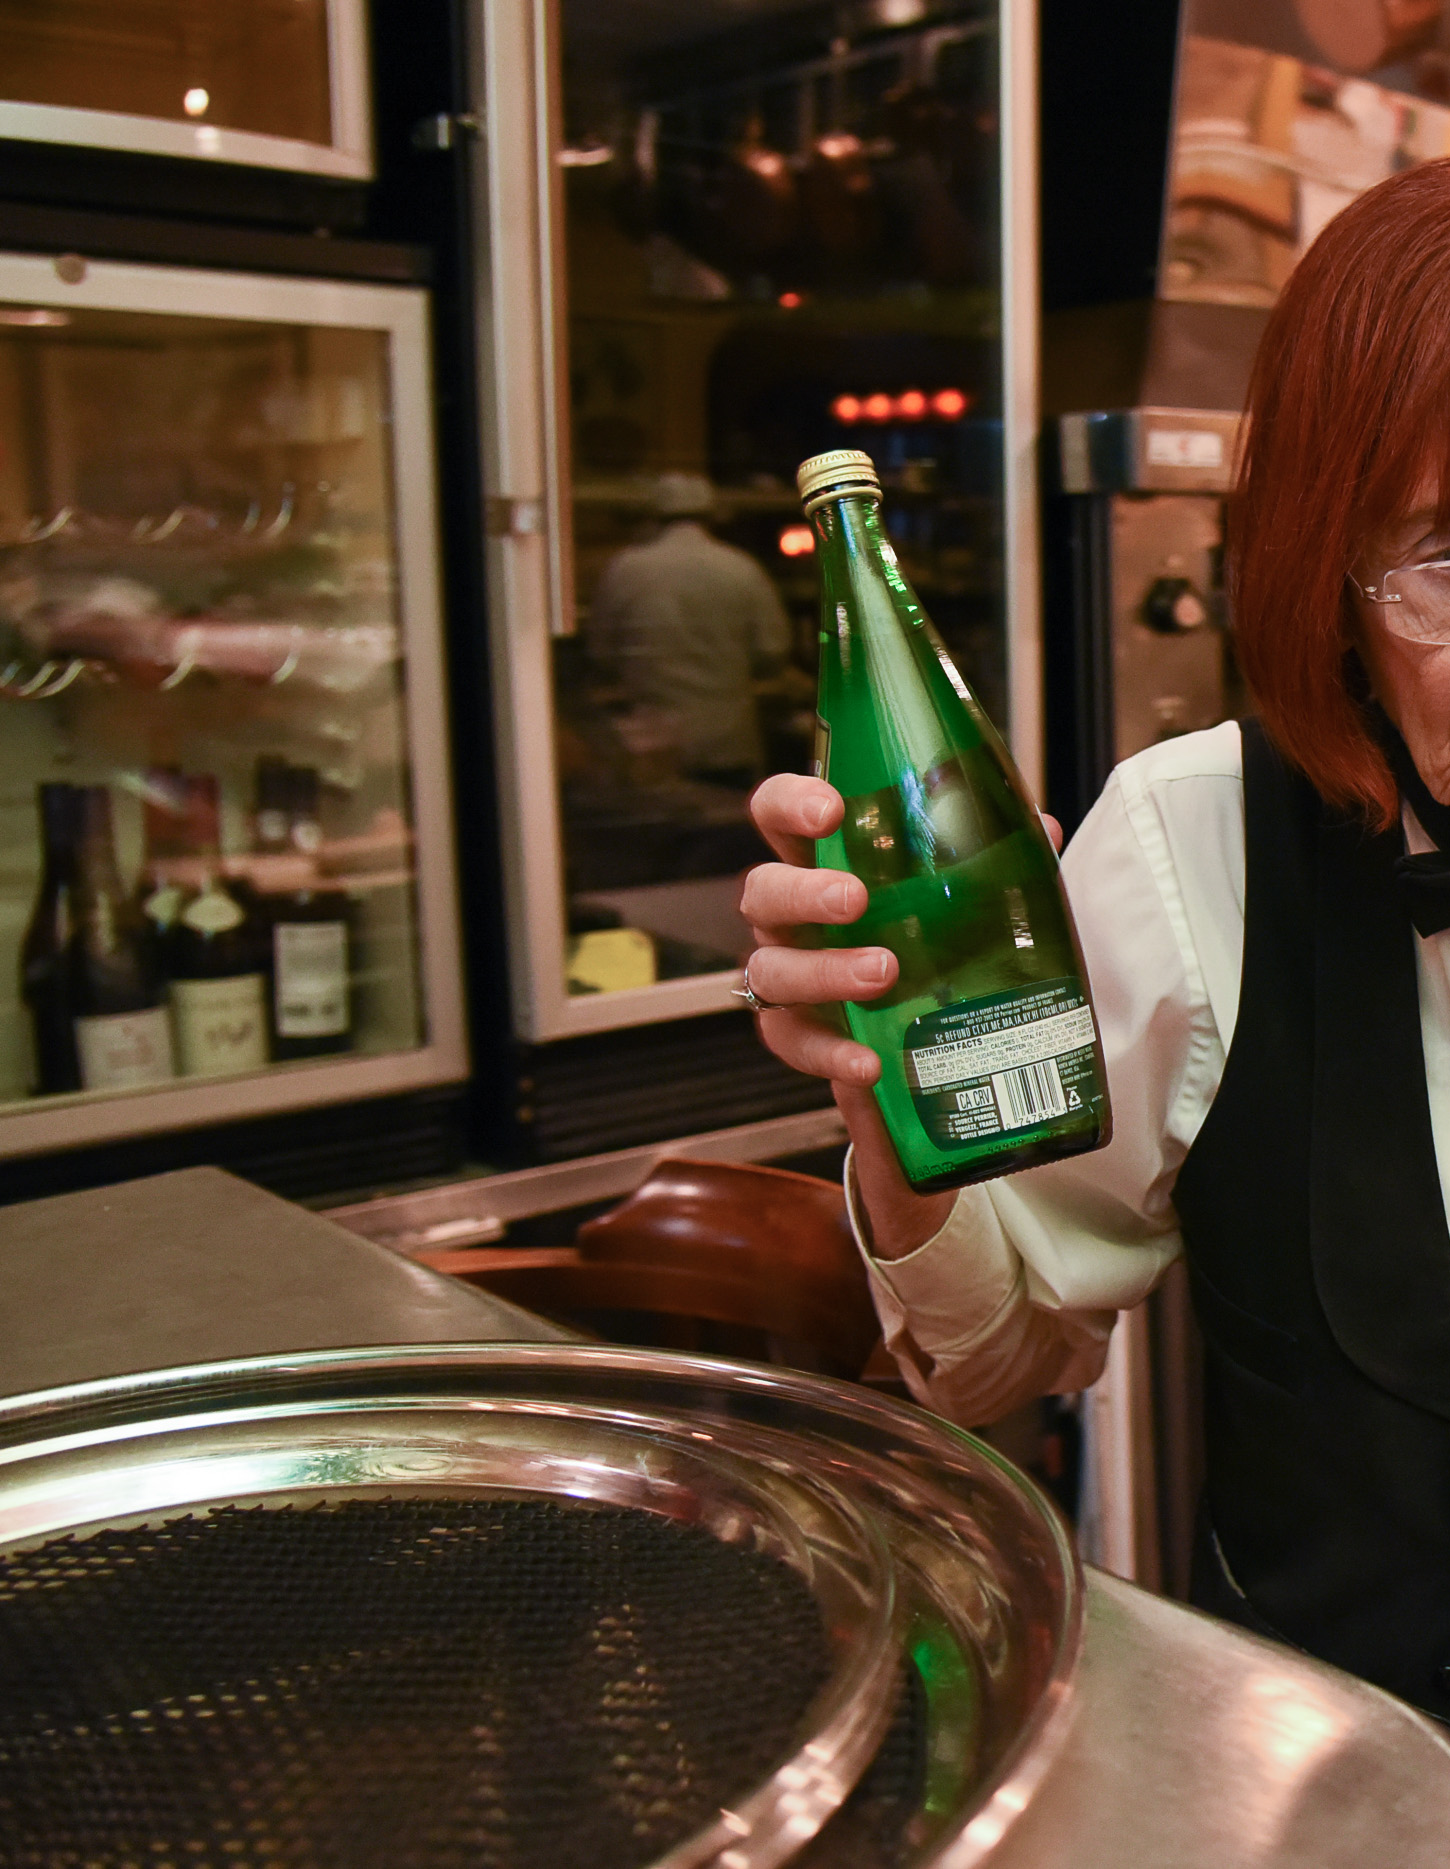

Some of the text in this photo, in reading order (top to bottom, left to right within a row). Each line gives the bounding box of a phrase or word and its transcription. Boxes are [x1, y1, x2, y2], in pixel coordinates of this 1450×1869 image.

[945, 1027, 970, 1041] REFUND
[915, 1045, 955, 1058] NUTRITION
[957, 1038, 982, 1050] FACTS
[984, 1034, 1005, 1044] SERVING
[936, 1053, 955, 1061] AMOUNT
[991, 1039, 1015, 1049] CALORIES
[976, 1051, 996, 1060] SUGARS
[920, 1071, 938, 1079] SOURCE
[934, 1074, 954, 1083] PERCENT
[970, 1067, 989, 1075] VALUES
[1012, 1057, 1027, 1065] BASED
[959, 1089, 990, 1109] CA CRV
[955, 1117, 973, 1125] SOURCE
[979, 1119, 998, 1127] FRANCE
